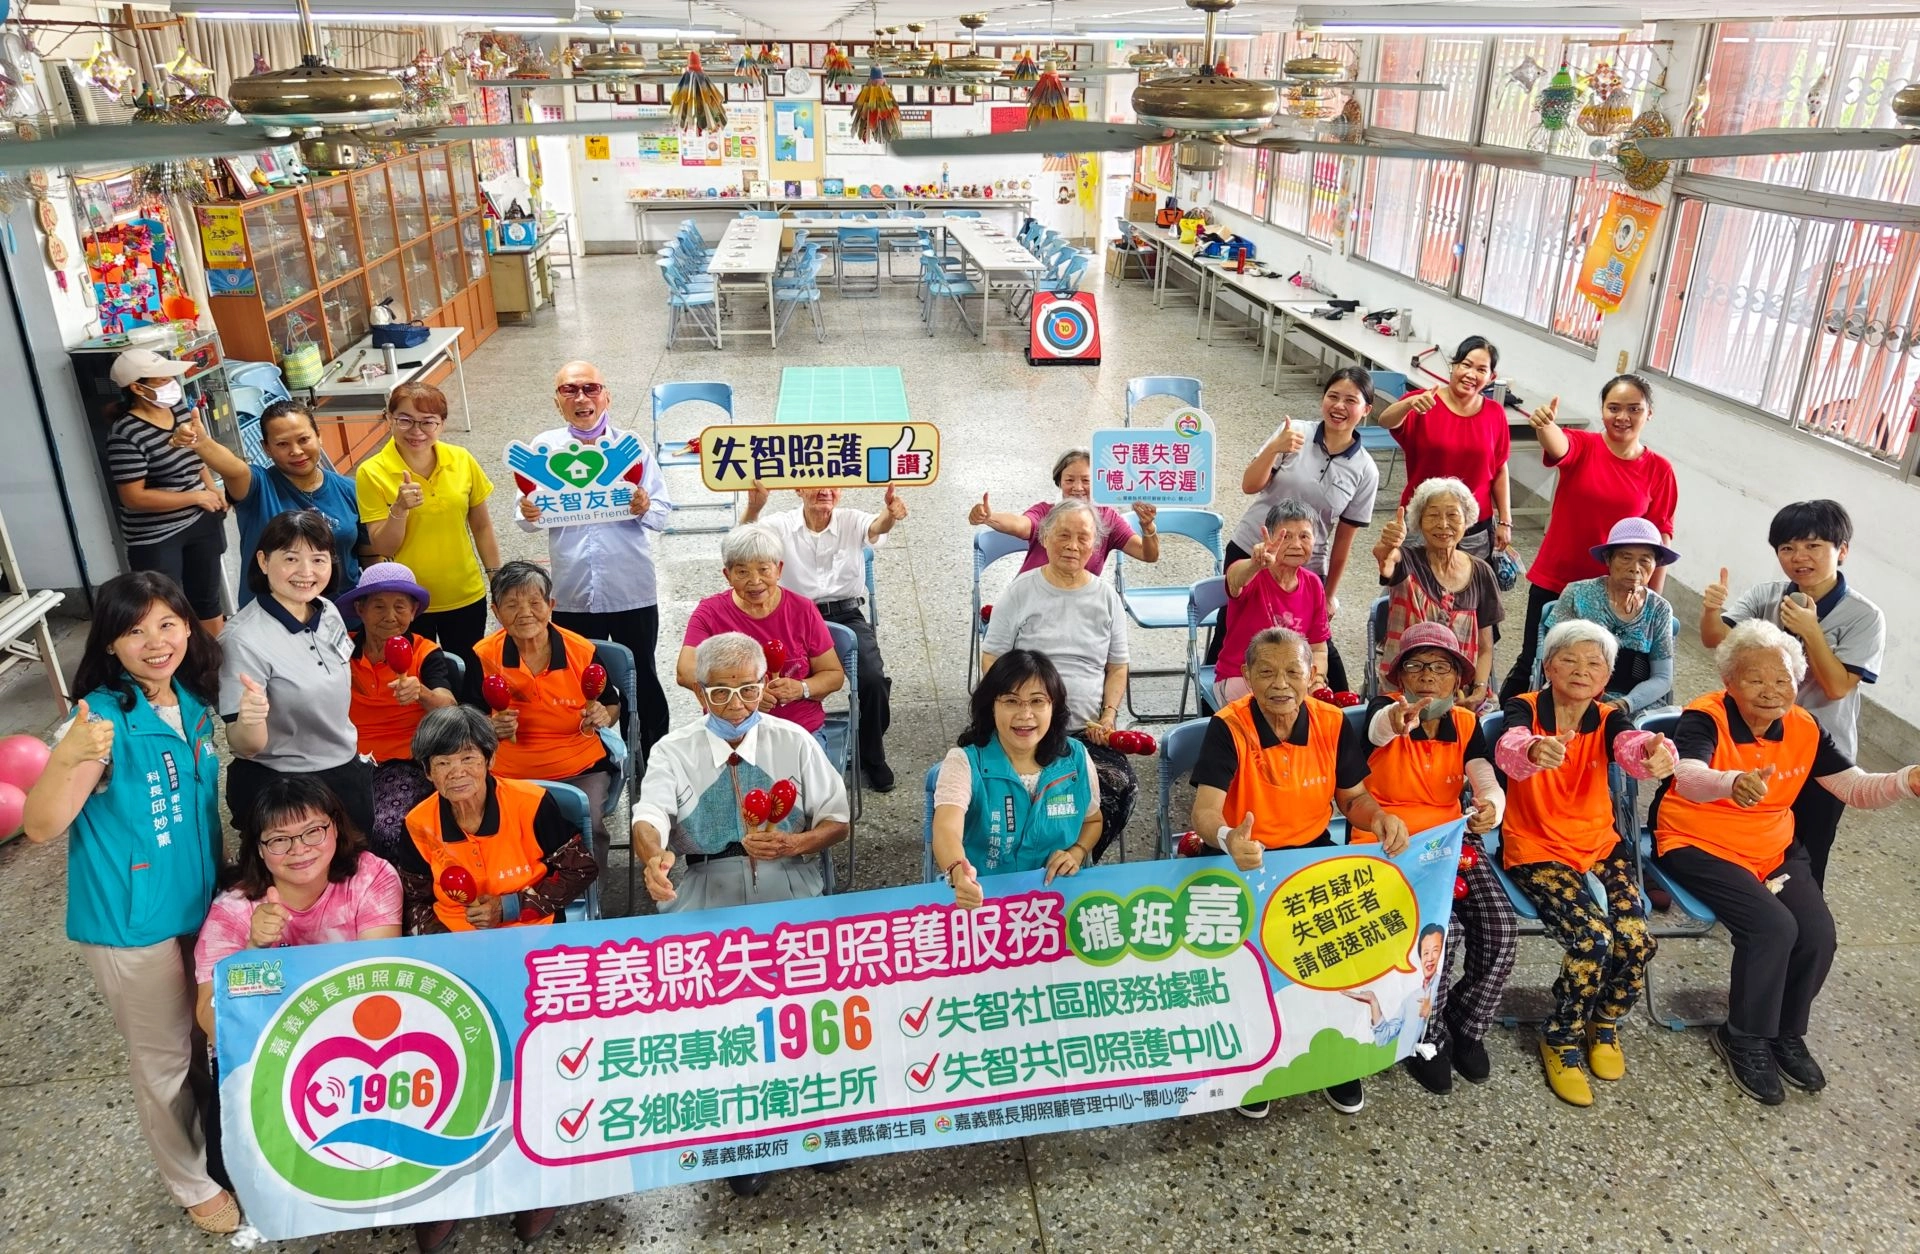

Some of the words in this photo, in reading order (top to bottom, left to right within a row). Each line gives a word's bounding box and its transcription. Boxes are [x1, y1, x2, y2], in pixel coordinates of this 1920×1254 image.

[712, 433, 862, 481] 失智照護
[897, 453, 920, 475] 讚
[1111, 443, 1191, 465] 守護失智
[534, 487, 633, 513] 失智友善
[538, 513, 591, 525] Dementia
[593, 507, 632, 519] Friend
[1282, 864, 1376, 919] 若有疑似
[1291, 888, 1382, 947] 失智症者
[532, 897, 1060, 1017] 嘉義縣失智照護服務
[1077, 884, 1243, 953] 攏抵嘉
[1292, 908, 1409, 981] 請儘速就醫
[229, 968, 261, 986] 健康
[936, 966, 1230, 1038] 失智社區服務據點
[268, 969, 482, 1058] 嘉義縣長期照顧管理中心
[943, 1020, 1243, 1093] 失智共同照護中心
[348, 1067, 436, 1116] 1966
[598, 1065, 878, 1143] 各鄉鎮市衛生所
[701, 1138, 789, 1167] 嘉義縣政府
[823, 1117, 927, 1149] 嘉義縣衛生局
[1209, 1088, 1225, 1098] 廣告
